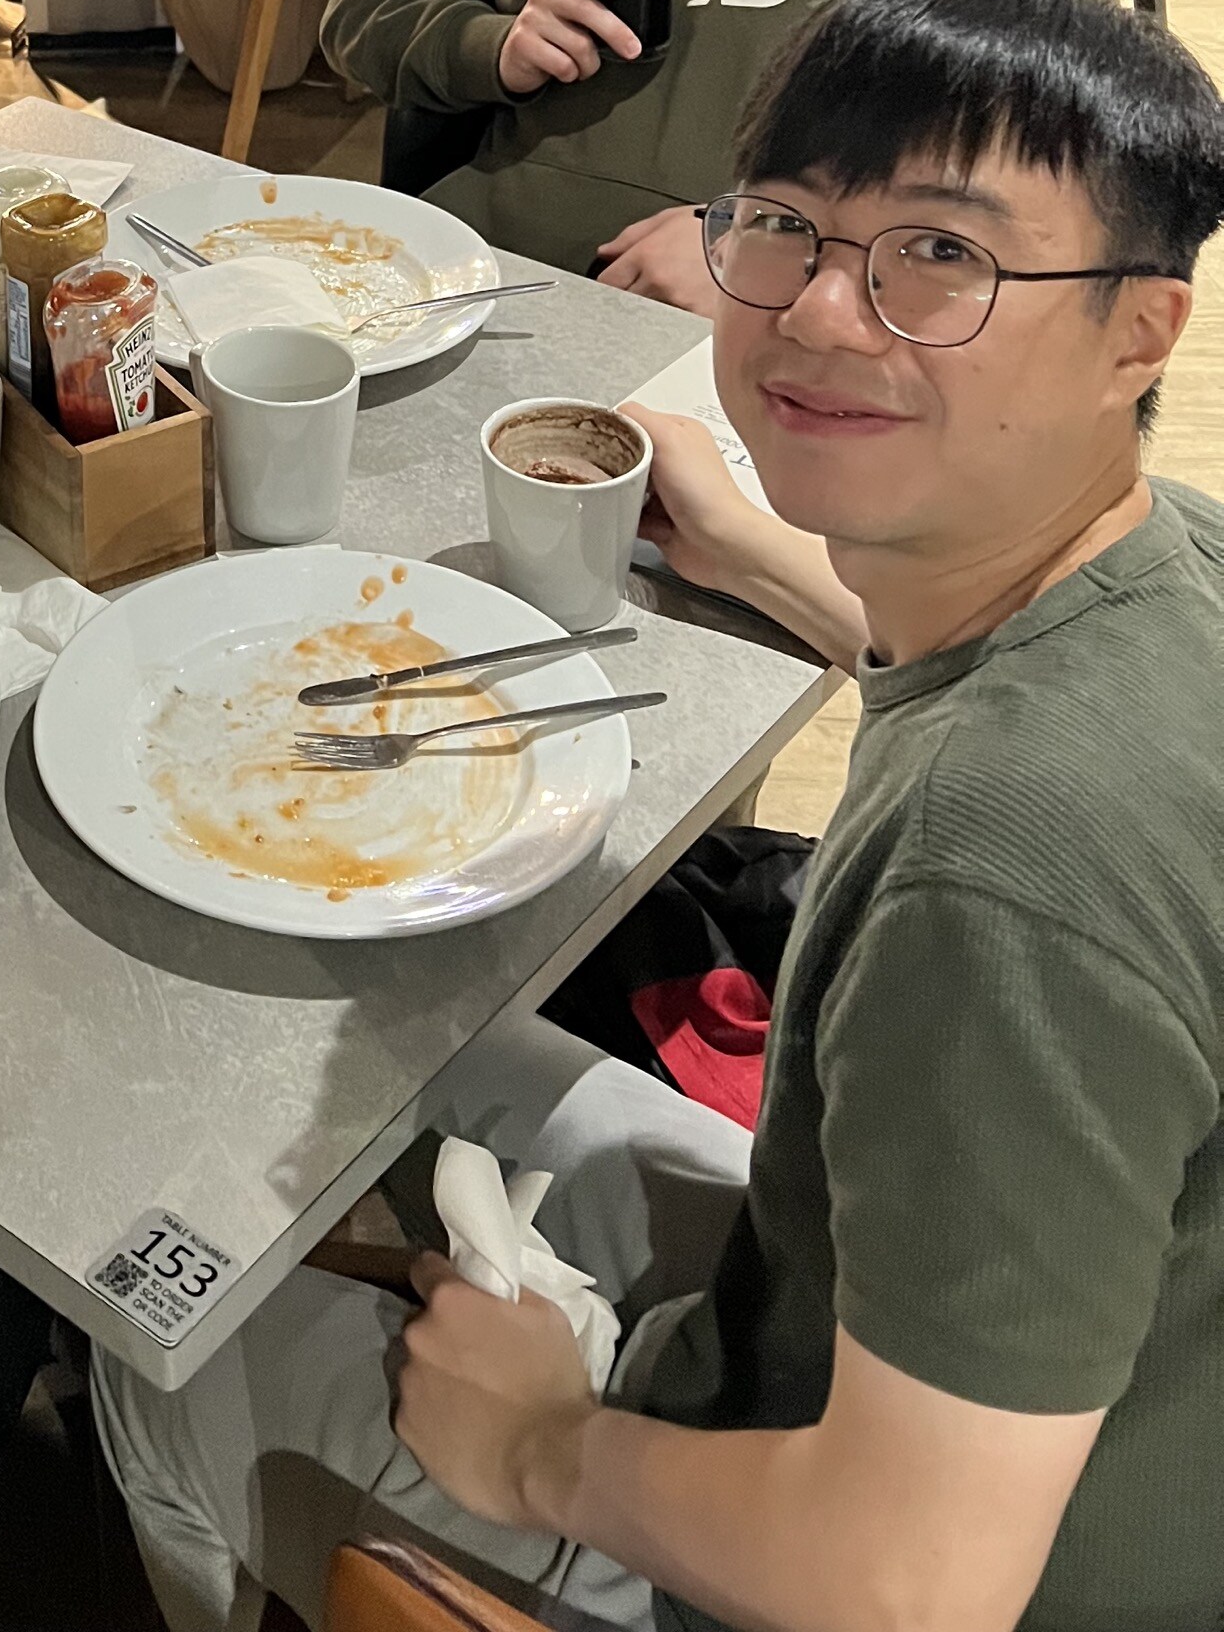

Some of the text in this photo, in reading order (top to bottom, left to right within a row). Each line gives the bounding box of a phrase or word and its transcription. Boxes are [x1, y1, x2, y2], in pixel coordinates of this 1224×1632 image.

[124, 325, 152, 358] HEINZ
[162, 1213, 232, 1266] TABLE NUMBER
[130, 1230, 219, 1298] 153
[132, 1297, 175, 1331] QR CODE
[138, 1286, 186, 1324] SCAN THE
[150, 1278, 194, 1314] TO ORDER
